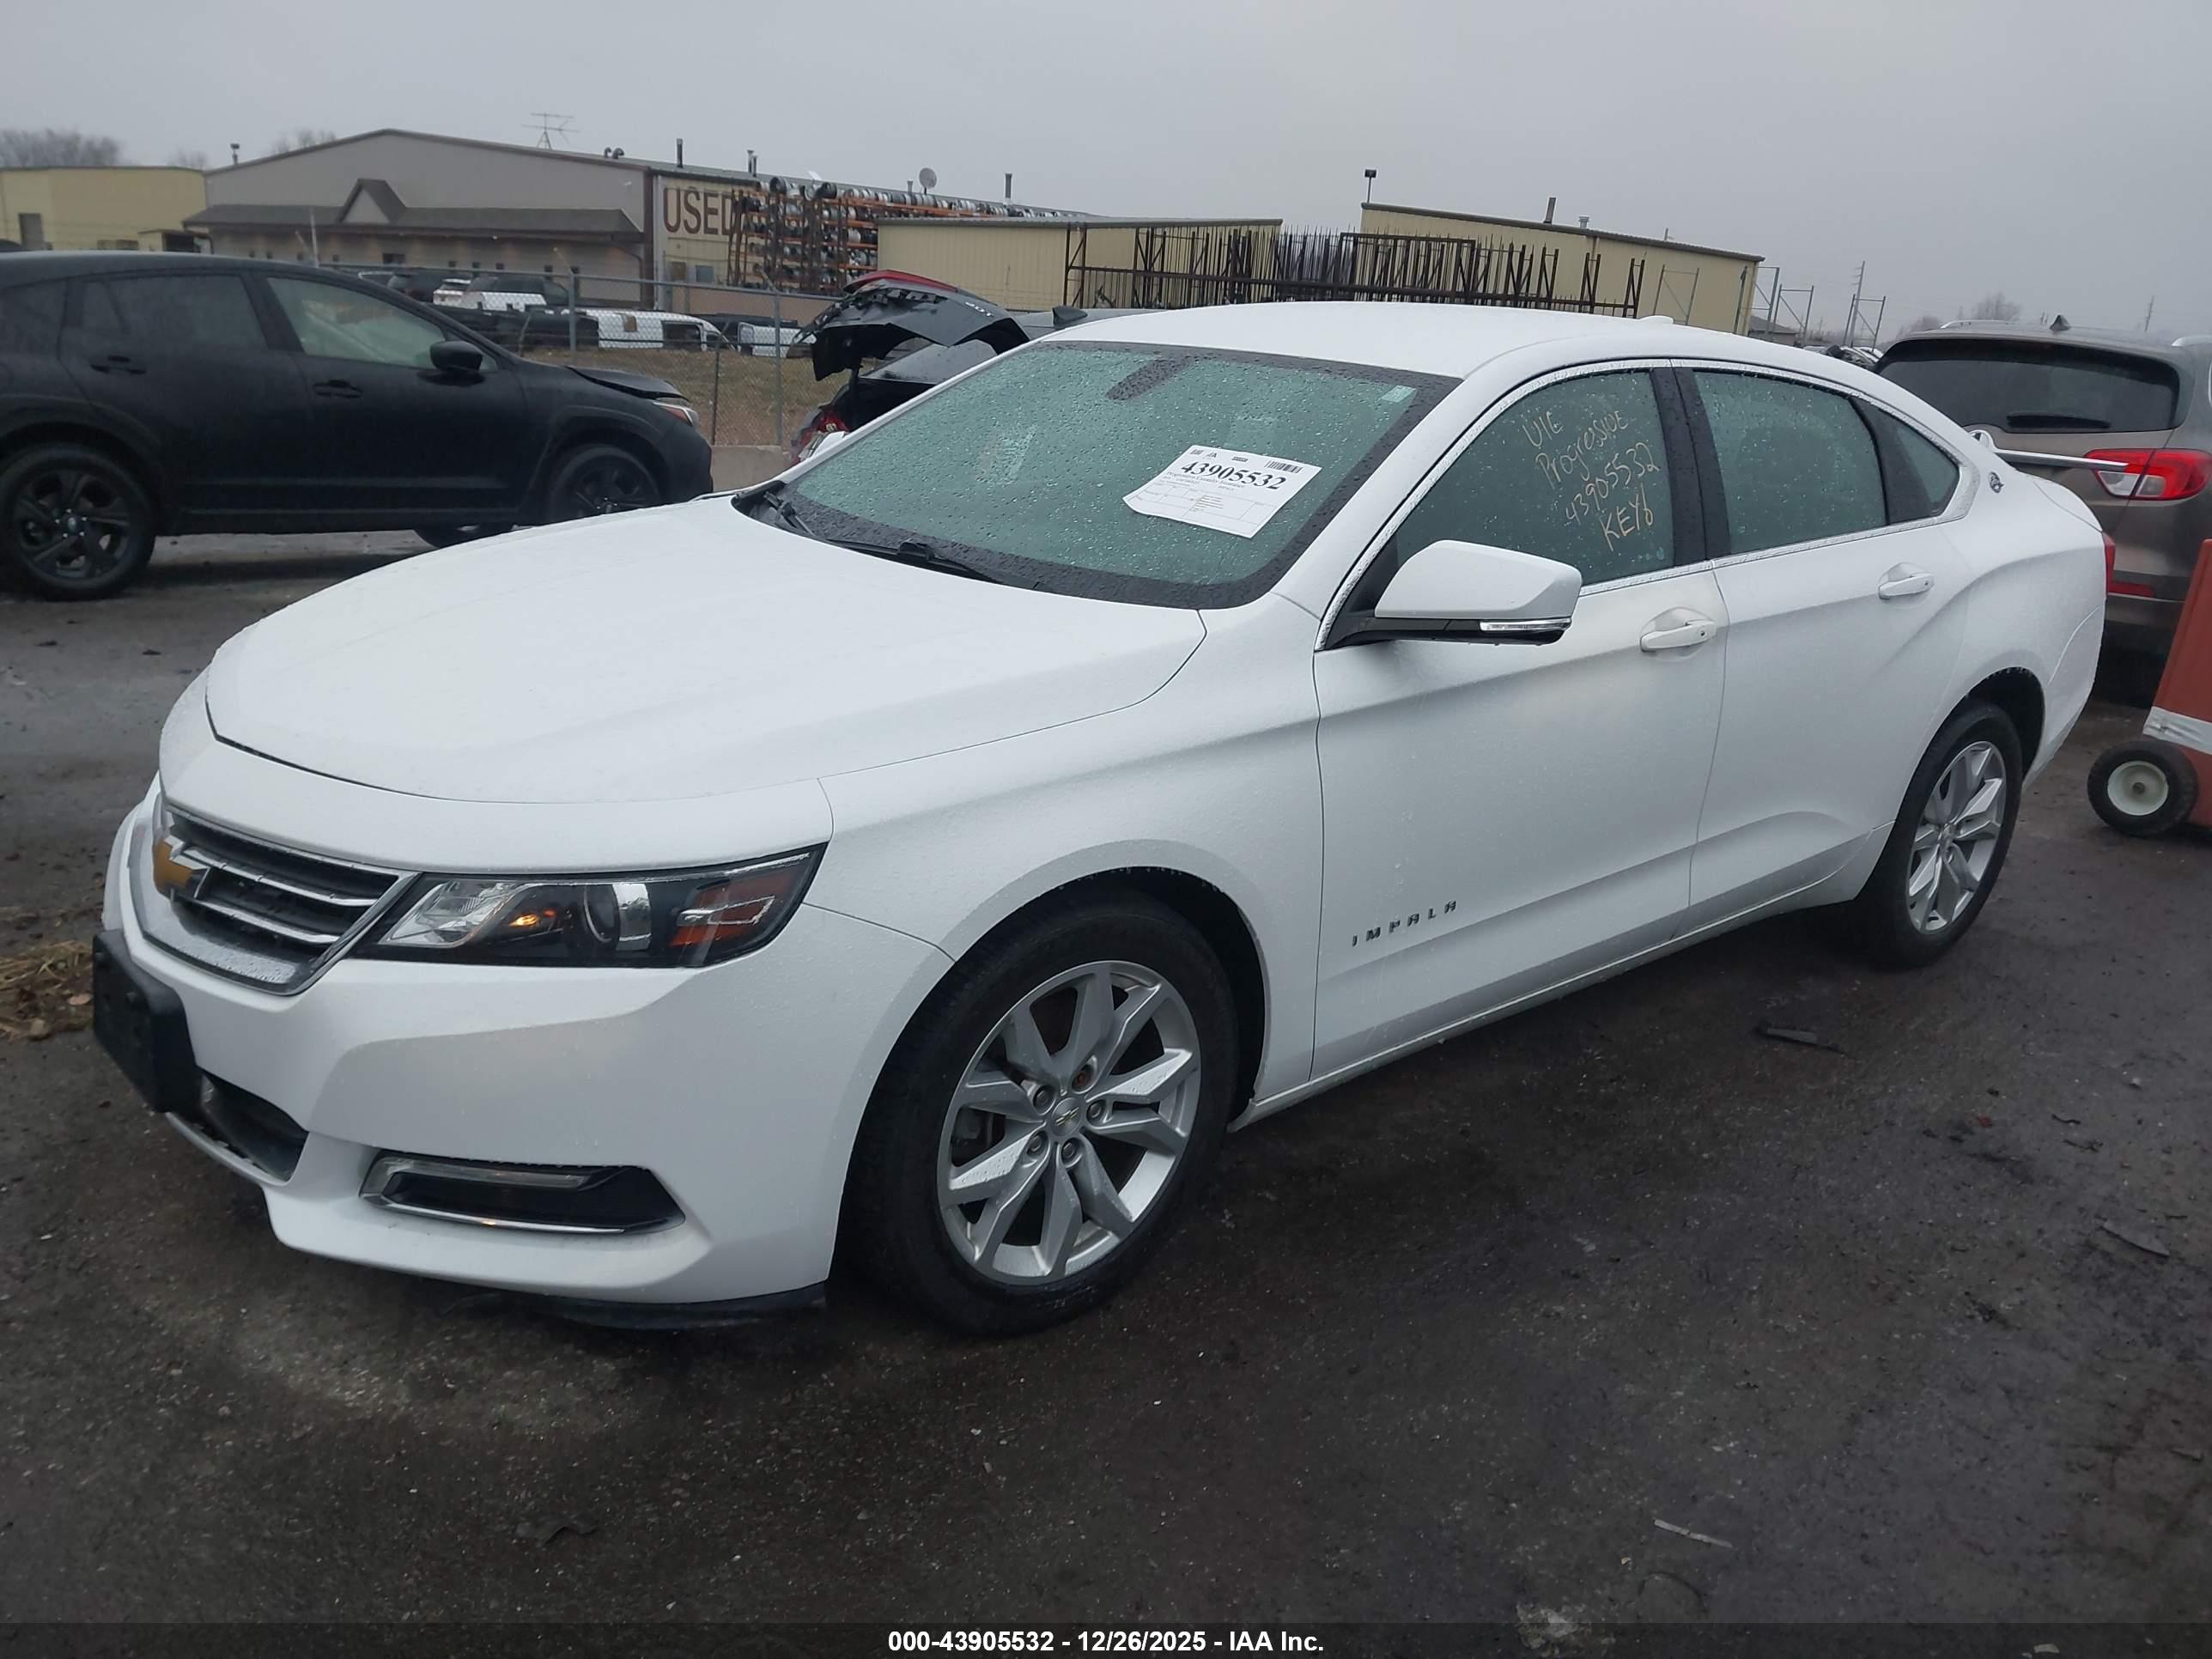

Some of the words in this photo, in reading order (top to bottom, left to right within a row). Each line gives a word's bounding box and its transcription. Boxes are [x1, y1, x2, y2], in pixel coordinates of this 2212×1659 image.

[1181, 460, 1286, 490] 43905532
[1565, 442, 1660, 526] 43905532
[1352, 900, 1457, 947] IMPALA
